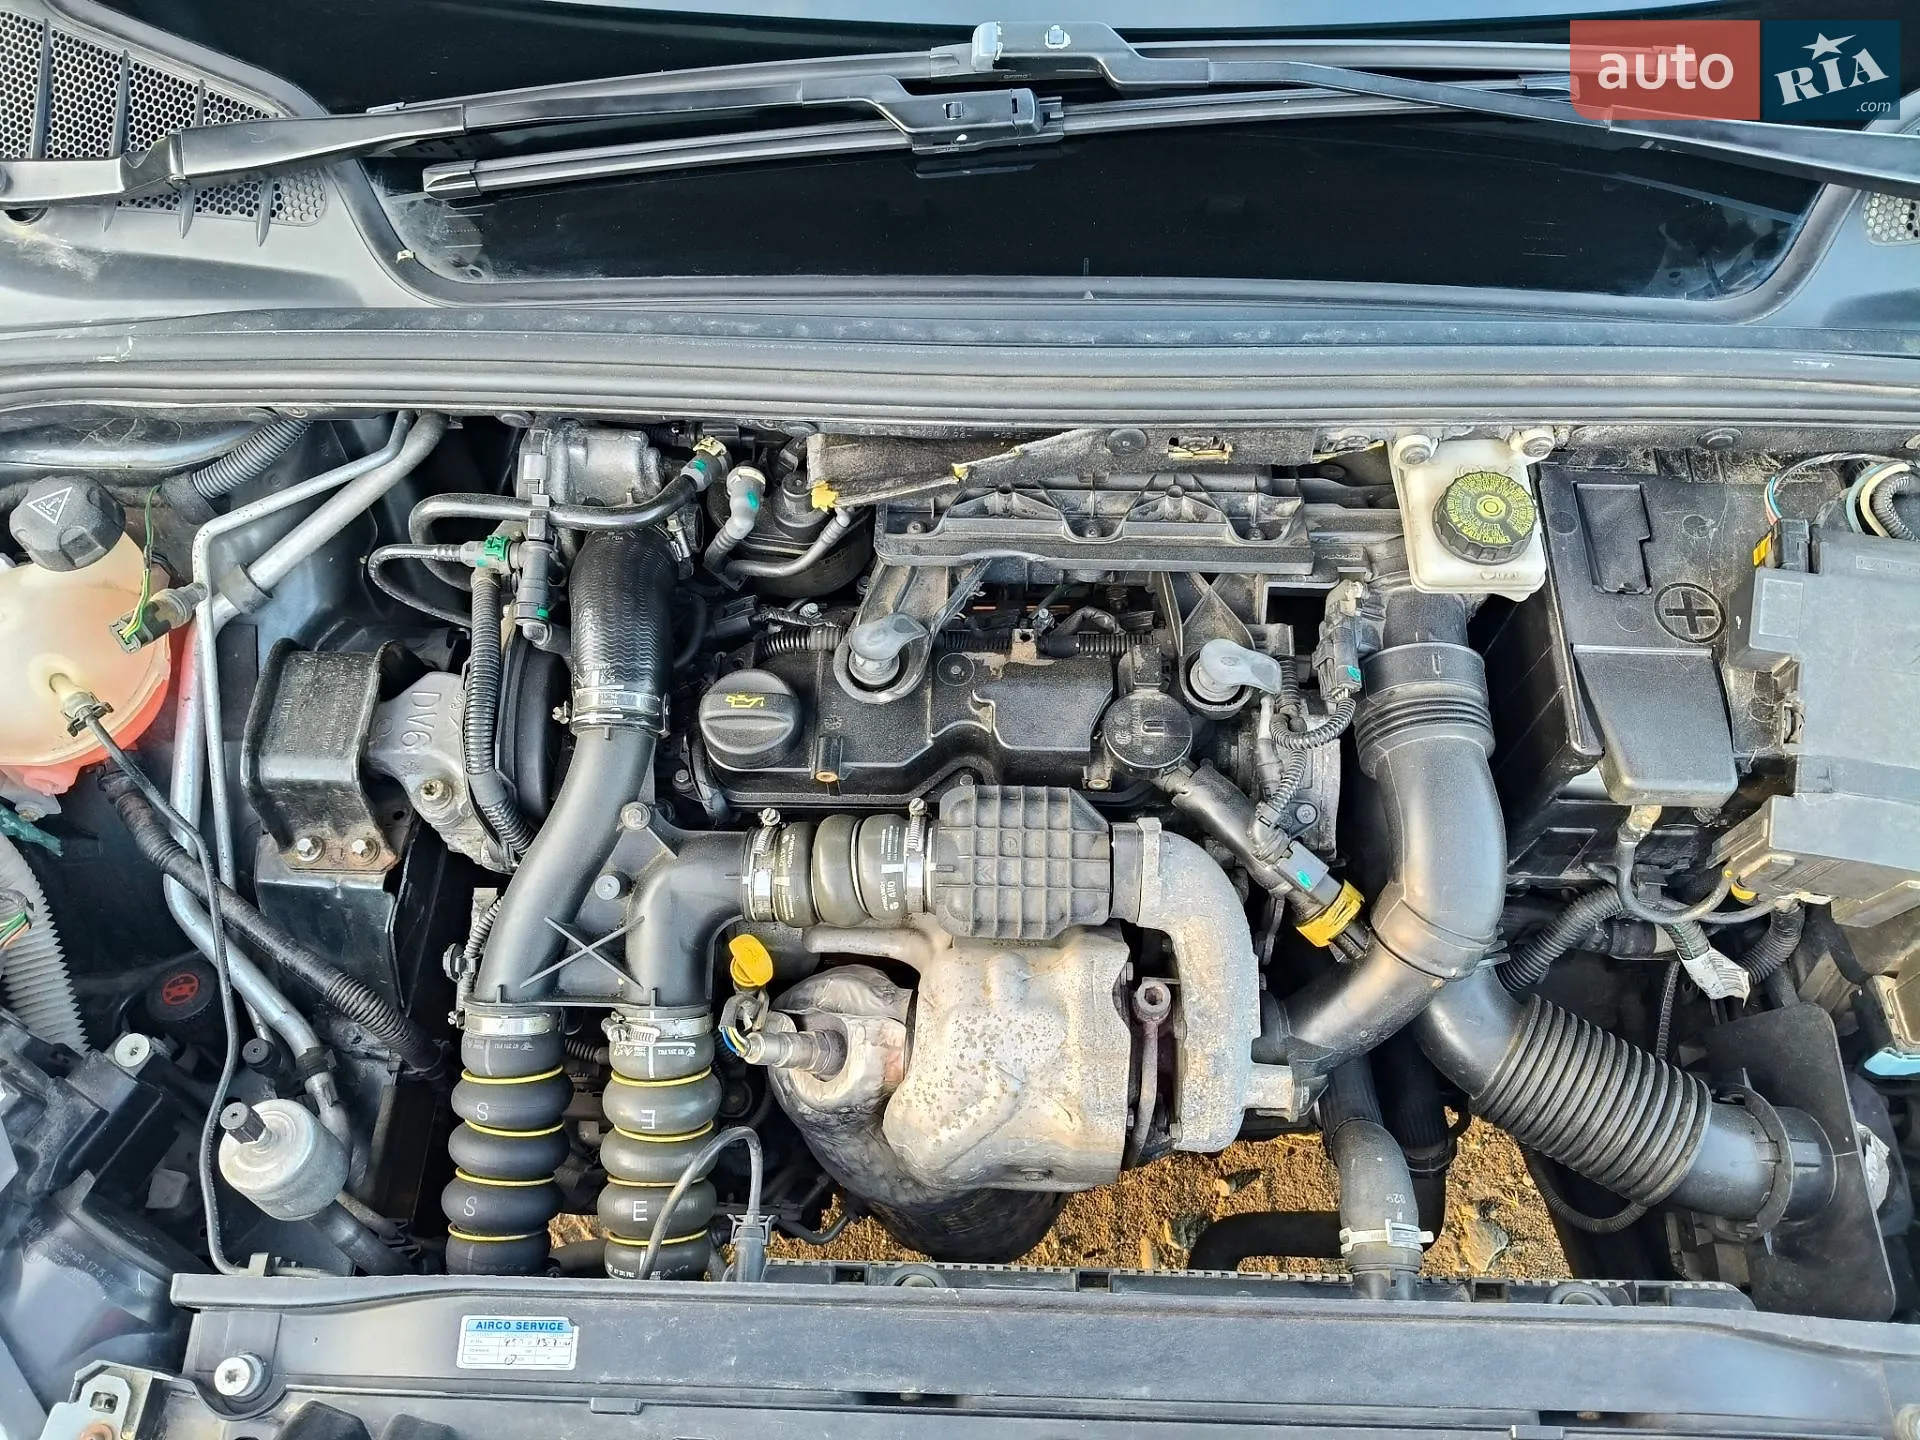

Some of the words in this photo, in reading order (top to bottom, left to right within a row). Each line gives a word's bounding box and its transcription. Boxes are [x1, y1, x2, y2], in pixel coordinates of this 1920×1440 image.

[401, 691, 442, 746] DV6
[476, 1102, 489, 1121] S
[640, 1109, 656, 1130] E
[463, 1195, 478, 1217] S
[632, 1200, 648, 1222] E
[476, 1321, 511, 1331] AIRCO
[515, 1322, 565, 1332] SERVICE
